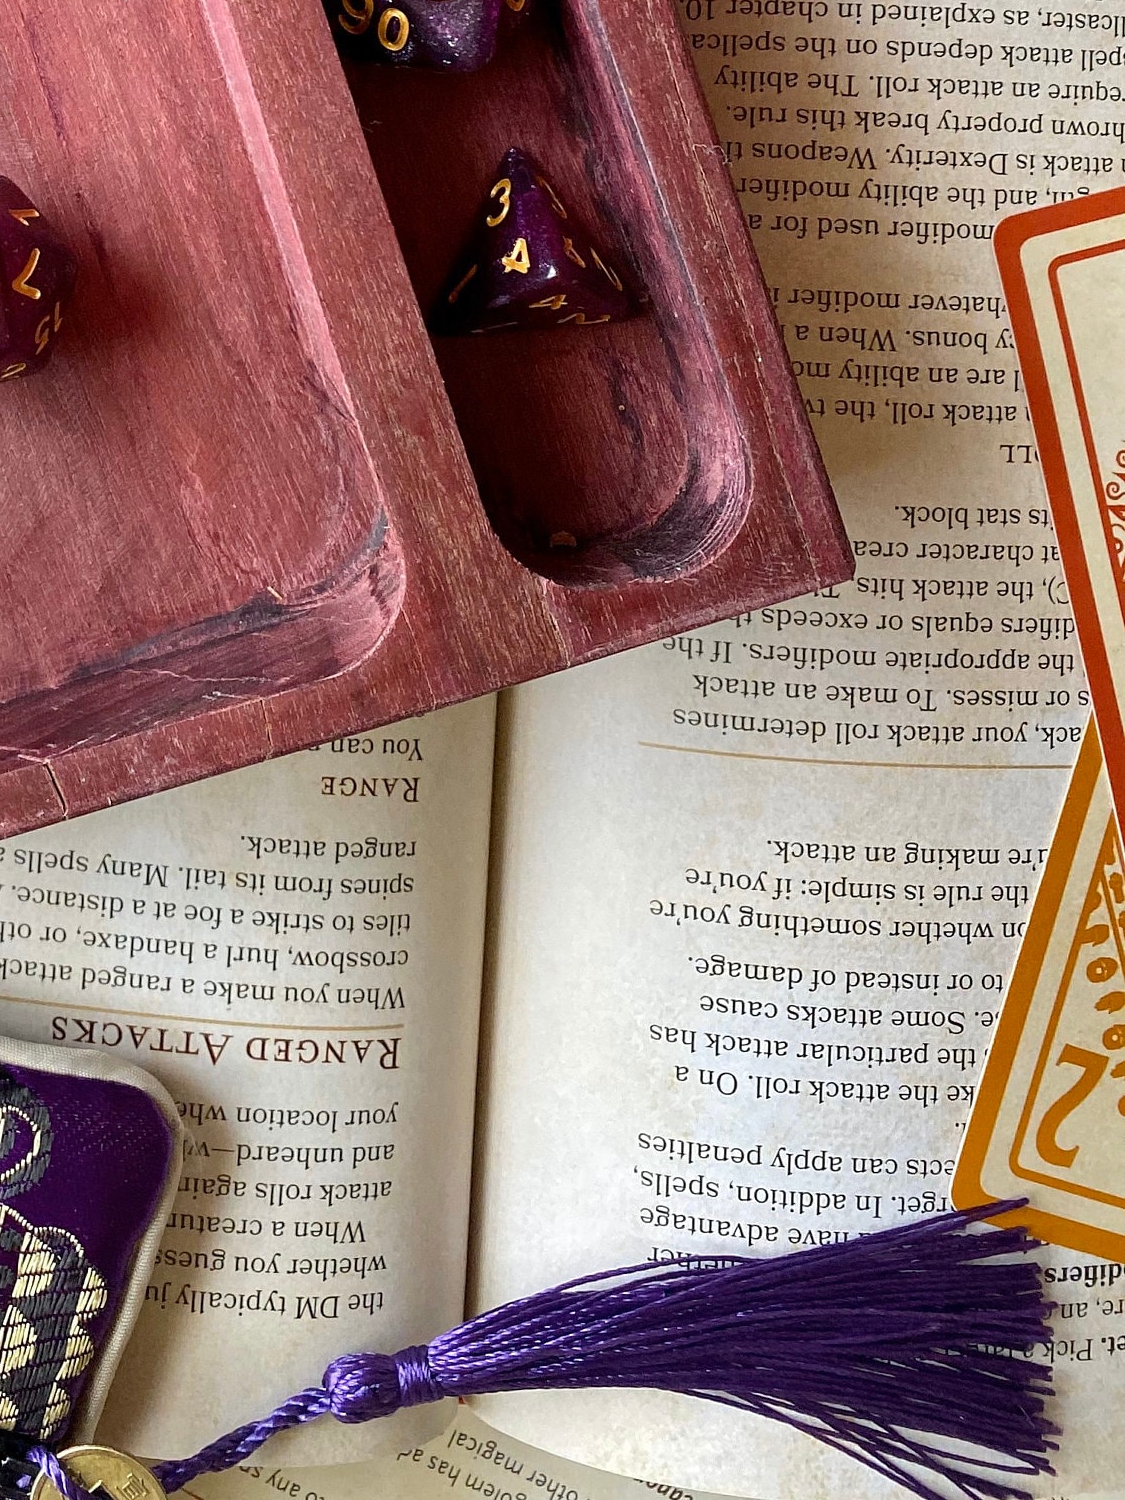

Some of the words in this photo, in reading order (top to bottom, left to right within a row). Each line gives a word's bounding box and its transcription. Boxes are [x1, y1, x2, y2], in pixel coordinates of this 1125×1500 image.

[871, 3, 995, 29] explained
[886, 38, 993, 66] depends
[886, 144, 1008, 175] Dexterity.
[895, 506, 969, 530] block.
[976, 508, 1021, 528] stat
[710, 641, 732, 663] If
[743, 643, 876, 671] modifiers.
[885, 648, 1030, 671] appropriate
[693, 675, 775, 699] attack
[785, 683, 817, 699] an
[826, 686, 898, 709] make
[1045, 690, 1070, 706] or
[906, 689, 937, 712] To
[947, 687, 1039, 712] misses.
[673, 709, 826, 743] determines
[835, 723, 879, 745] roll
[886, 725, 964, 747] attack
[972, 722, 1028, 742] your
[321, 777, 420, 802] RANGE
[241, 836, 326, 860] attack.
[335, 837, 416, 864] ranged
[686, 869, 767, 894] you're
[772, 878, 792, 900] if
[801, 877, 897, 905] simple:
[904, 885, 925, 900] is
[933, 885, 983, 908] rule
[991, 886, 1029, 908] the
[650, 900, 731, 925] you're
[738, 906, 882, 939] something
[890, 919, 995, 946] whether
[82, 966, 171, 991] ranged
[181, 978, 194, 993] a
[204, 981, 274, 1005] make
[284, 983, 330, 1003] you
[337, 987, 405, 1010] When
[700, 996, 778, 1018] cause
[787, 1005, 882, 1029] attacks
[891, 1011, 965, 1037] Some
[51, 1016, 233, 1065] ATTACKS
[650, 1025, 696, 1053] has
[704, 1033, 788, 1058] attack
[246, 1038, 402, 1069] RANGED
[797, 1043, 930, 1068] particular
[937, 1048, 976, 1071] the
[675, 1066, 689, 1081] a
[699, 1069, 737, 1095] On
[749, 1075, 801, 1099] roll.
[808, 1081, 889, 1104] attack
[1036, 1043, 1109, 1168] 2
[638, 1133, 762, 1165] penalties
[770, 1147, 842, 1175] apply
[851, 1156, 898, 1174] can
[634, 1166, 719, 1197] spells,
[729, 1181, 846, 1216] addition,
[855, 1195, 883, 1218] In
[640, 1205, 778, 1247] advantage
[447, 1430, 523, 1475] magical
[427, 1456, 461, 1487] has
